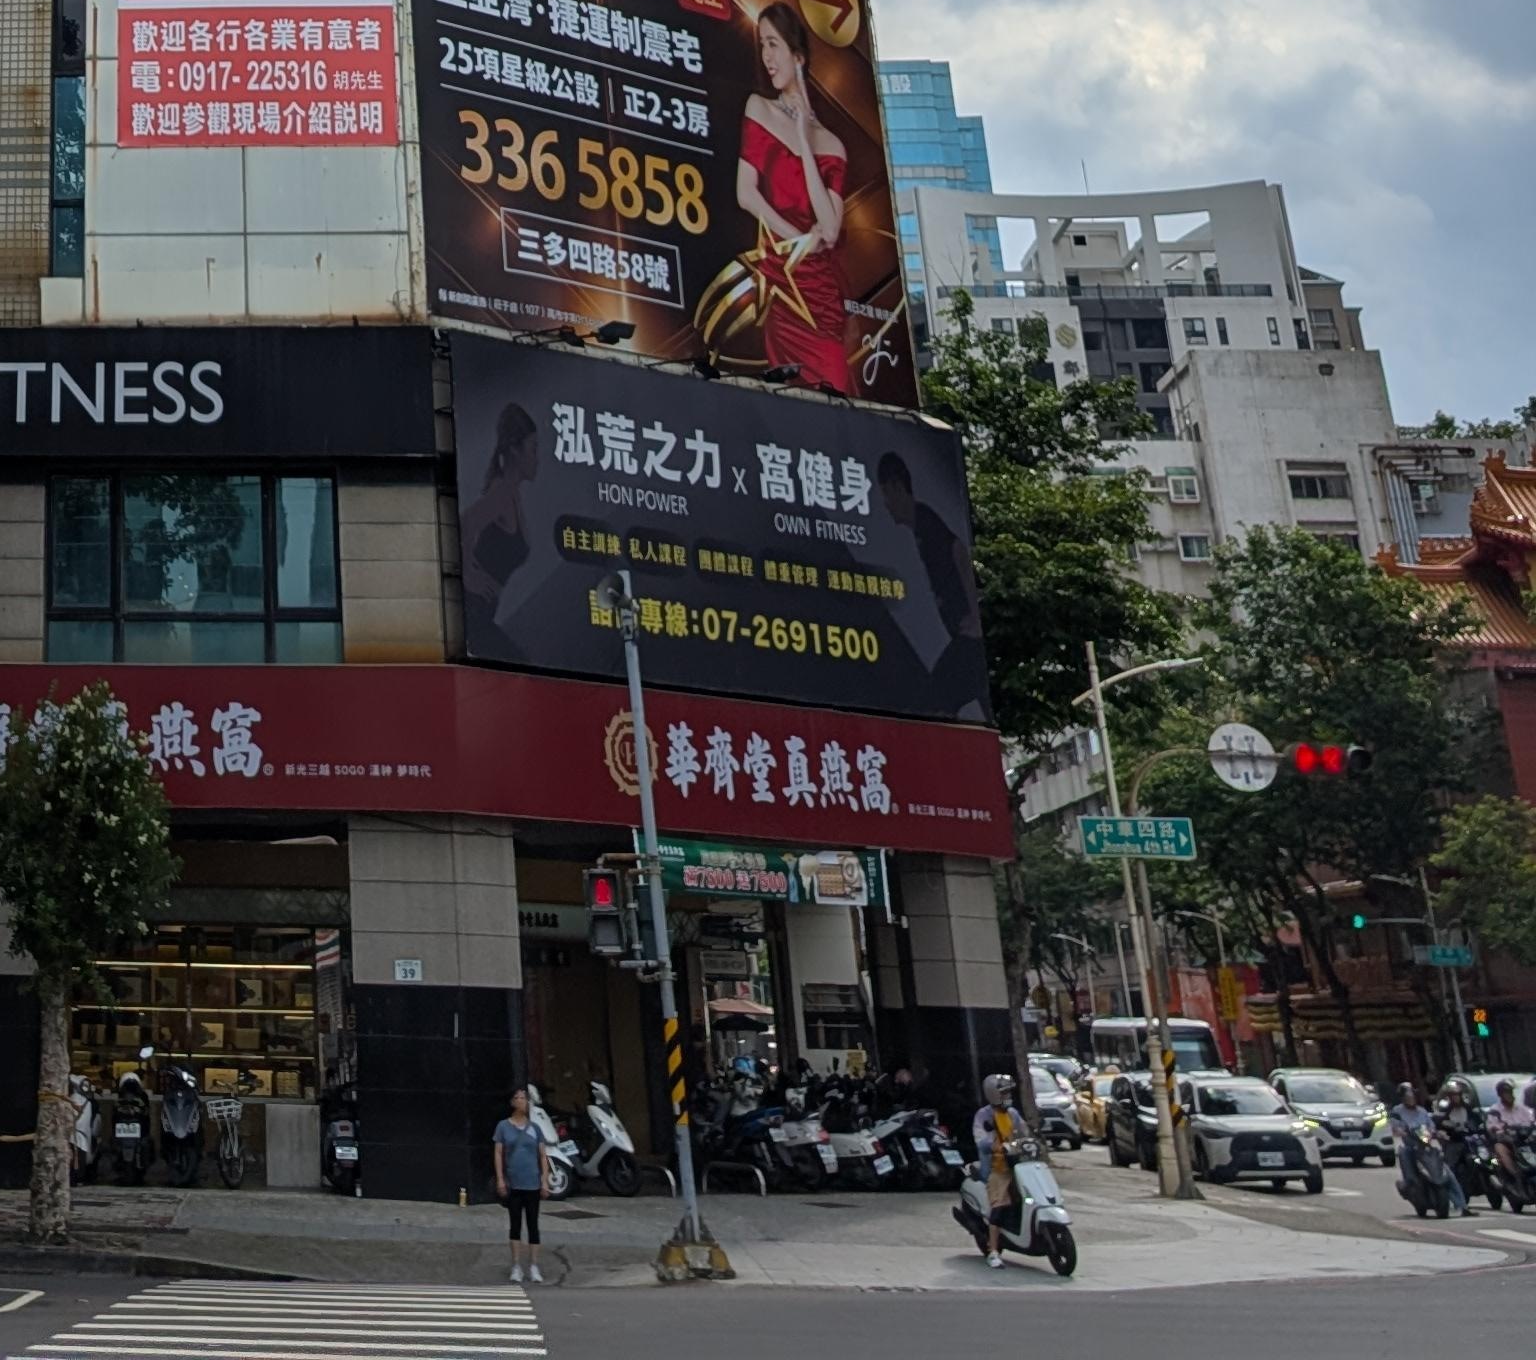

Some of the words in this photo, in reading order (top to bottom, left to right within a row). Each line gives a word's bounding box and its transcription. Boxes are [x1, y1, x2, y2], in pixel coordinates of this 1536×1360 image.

[132, 18, 382, 53] 歡迎各行各業有意者
[333, 70, 383, 90] 胡先生
[438, 37, 601, 109] 25項星級公設
[622, 84, 711, 138] 正2-3房
[457, 109, 567, 201] 336
[577, 136, 710, 235] 5858
[517, 227, 671, 293] 三多四路58號
[552, 402, 722, 489] 泓荒之力
[598, 482, 633, 507] HON
[636, 487, 689, 516] POWER
[563, 527, 622, 556] 自主訓練
[629, 537, 687, 567] 私人課程
[774, 512, 811, 537] OWN
[815, 518, 867, 546] FITNESS
[664, 720, 892, 815] 華齊堂真燕窩
[1096, 821, 1176, 838] 中華四路
[400, 967, 416, 979] 39
